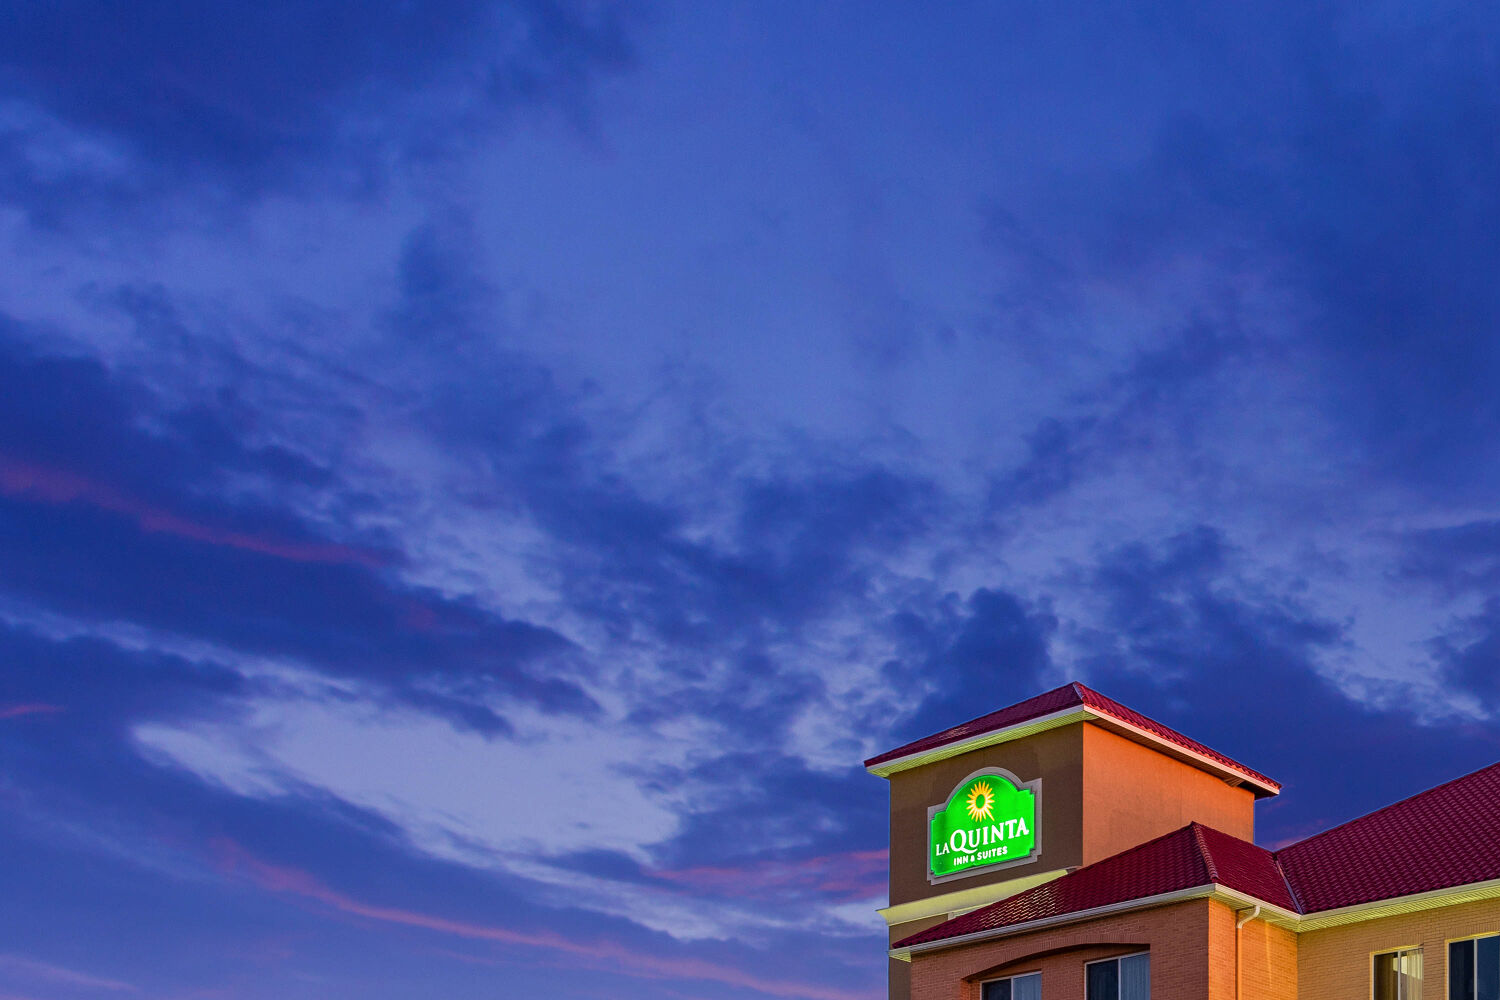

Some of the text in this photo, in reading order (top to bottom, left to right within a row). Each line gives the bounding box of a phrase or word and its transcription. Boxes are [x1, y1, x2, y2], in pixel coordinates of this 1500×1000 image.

[935, 817, 1030, 856] LA QUINTA
[953, 855, 969, 866] INN
[977, 846, 1008, 861] SUITES
